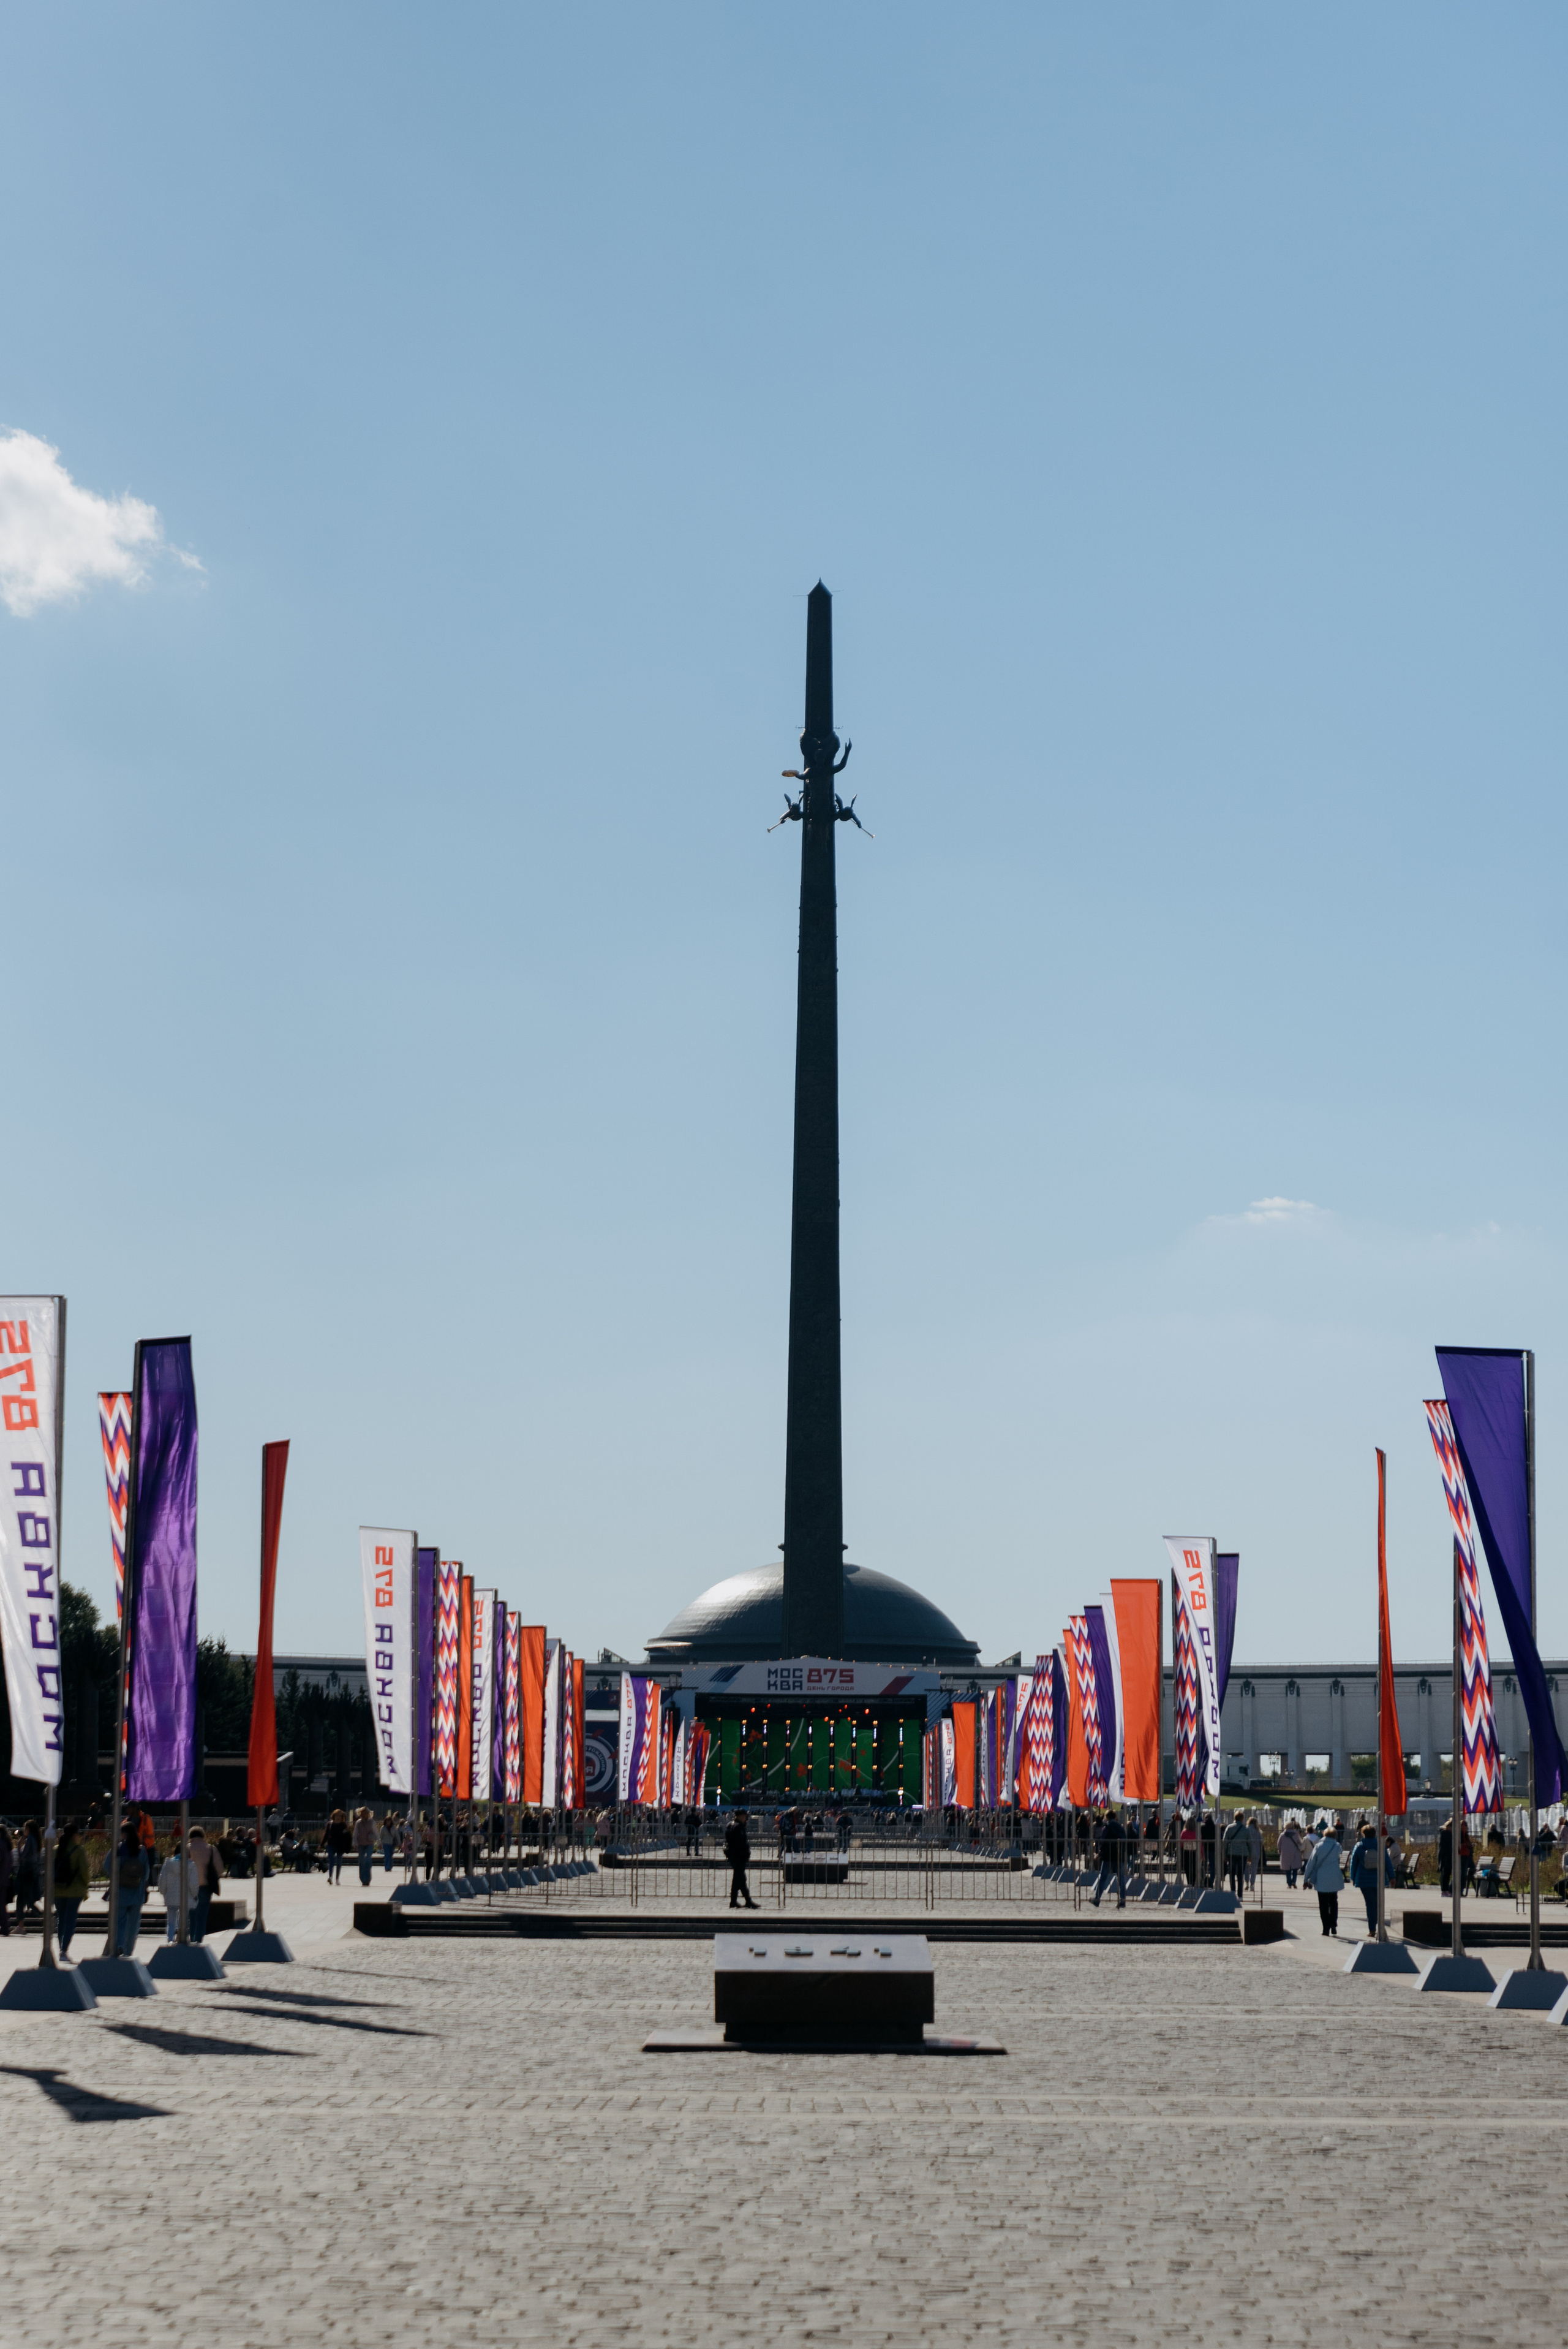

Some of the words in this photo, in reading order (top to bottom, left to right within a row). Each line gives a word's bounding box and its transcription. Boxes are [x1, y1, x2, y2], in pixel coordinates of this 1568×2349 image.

[767, 1668, 803, 1679] МОС
[807, 1668, 854, 1683] 875
[767, 1680, 803, 1690] КВА
[622, 1716, 632, 1791] МОСКВА
